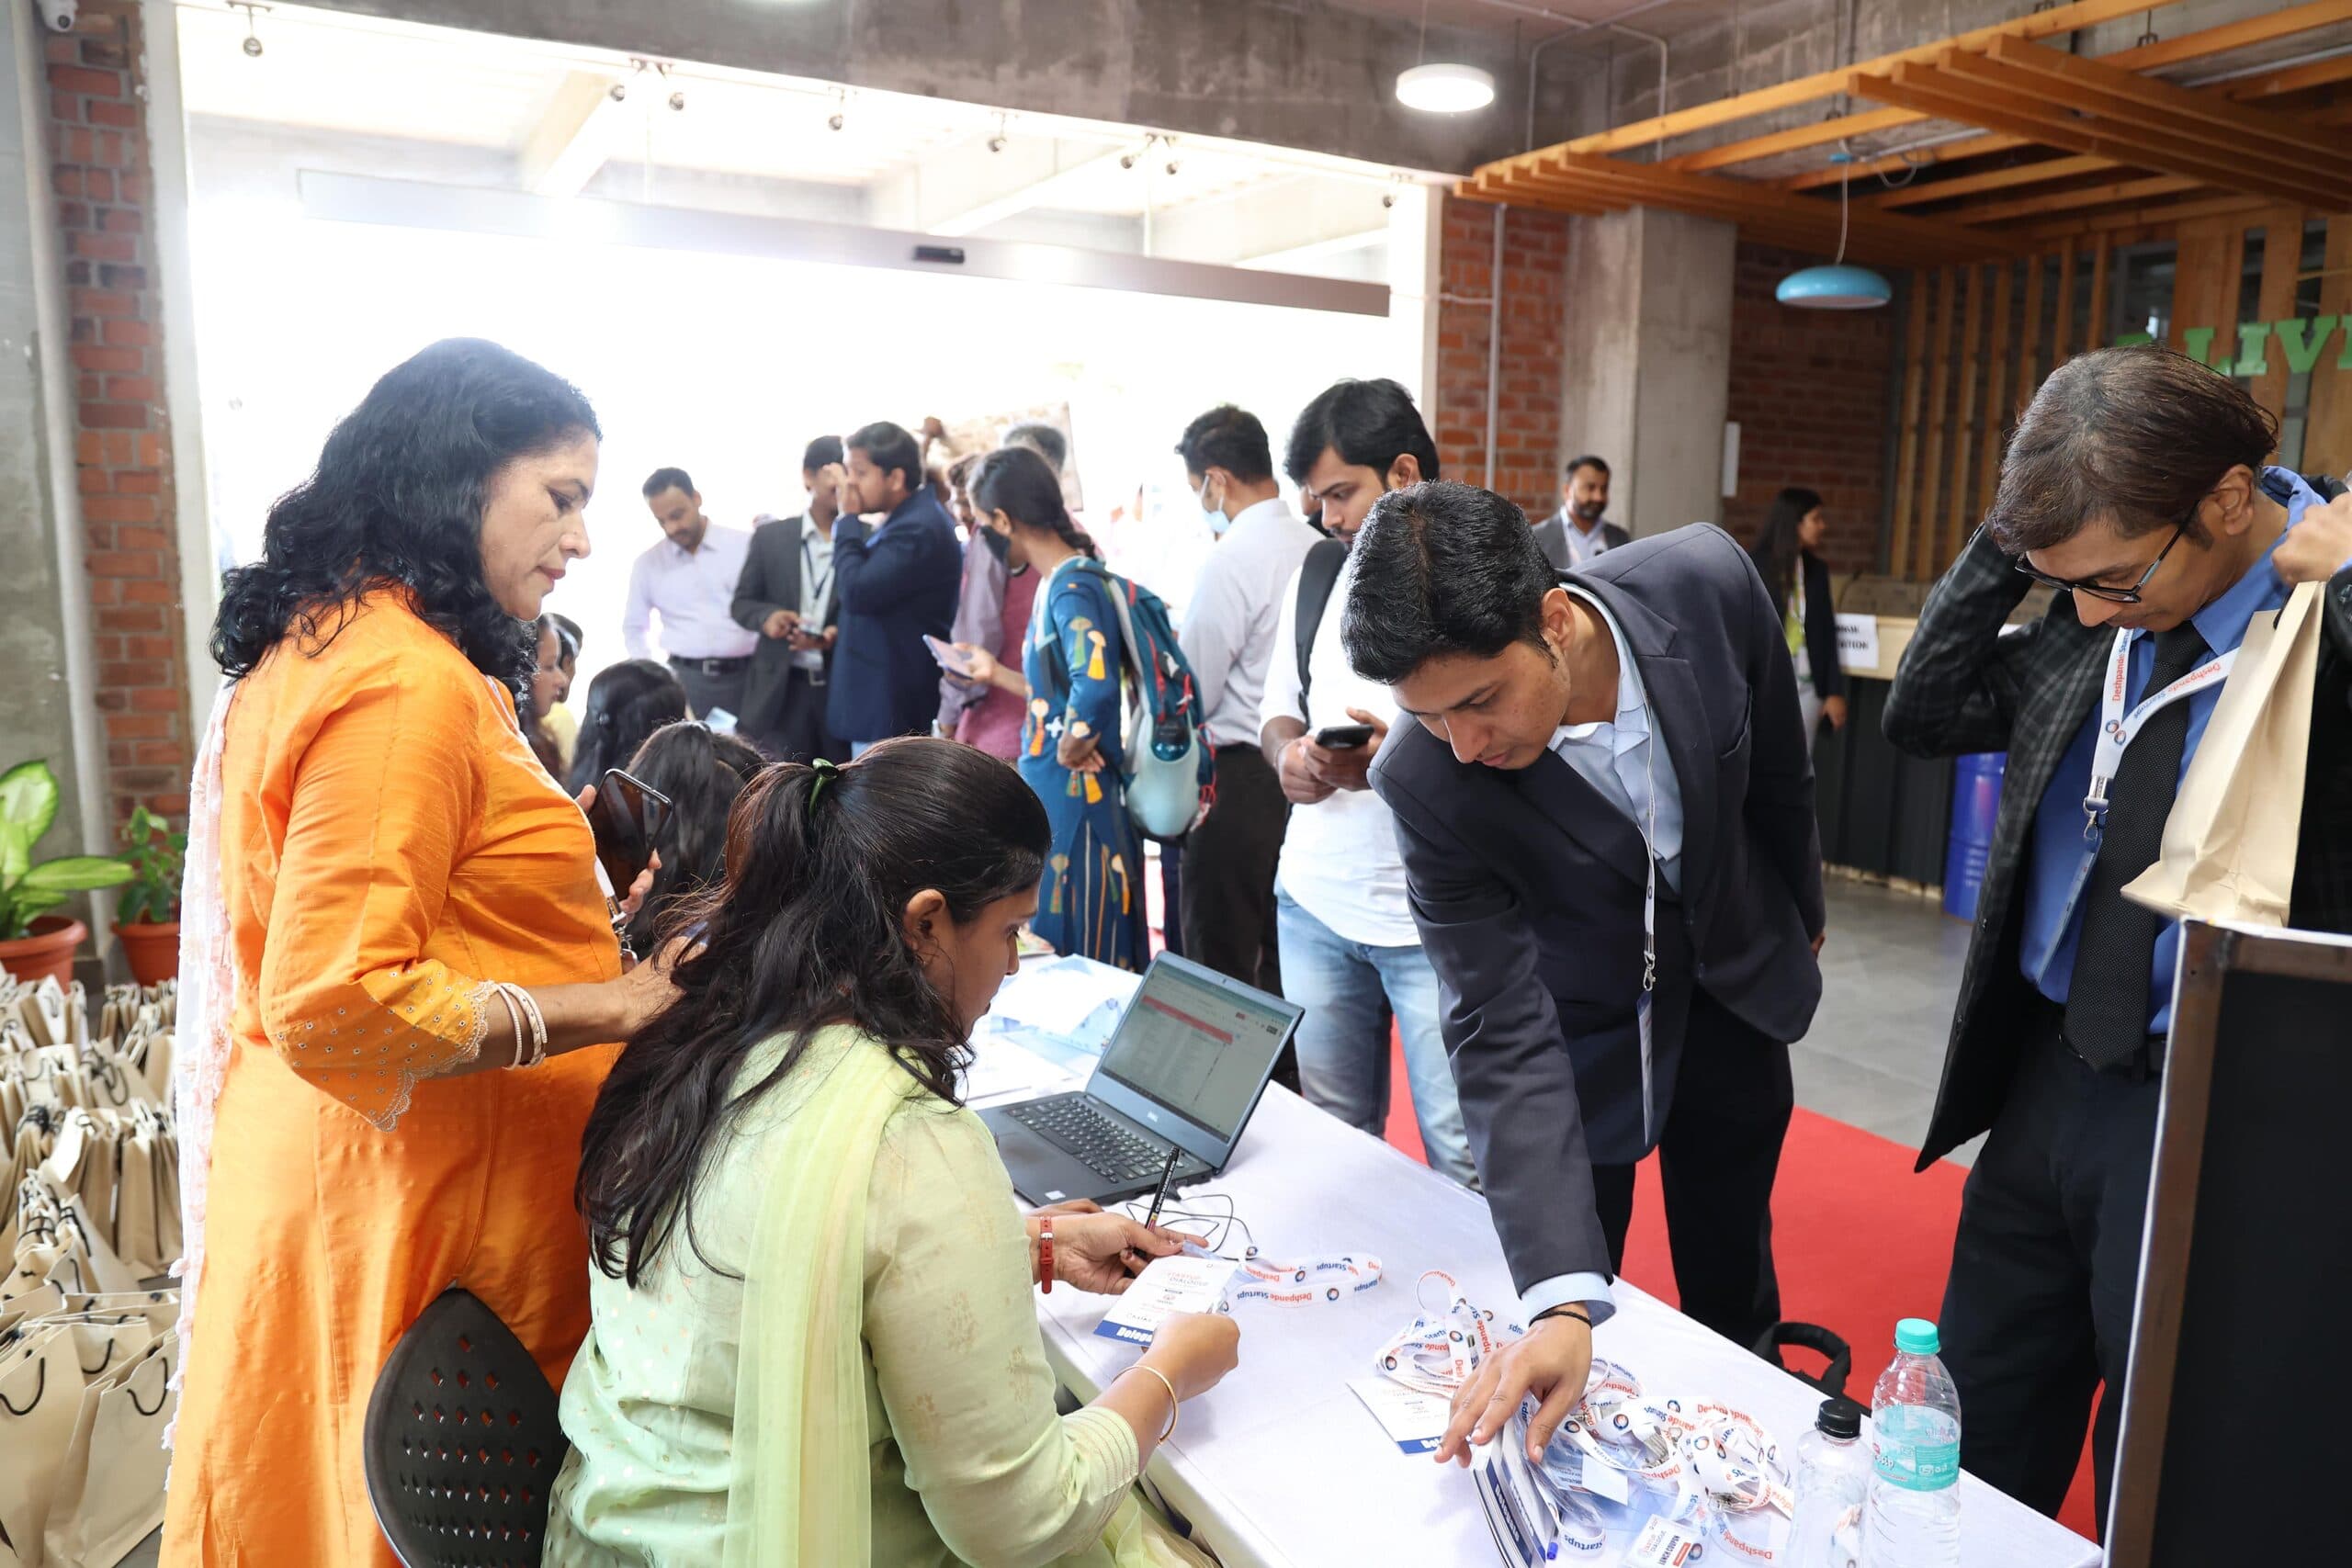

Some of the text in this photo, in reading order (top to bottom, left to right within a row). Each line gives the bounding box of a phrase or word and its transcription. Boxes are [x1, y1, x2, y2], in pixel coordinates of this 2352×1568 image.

[2183, 315, 2352, 377] LIV
[1237, 1290, 1312, 1303] Deshpande Startups
[1477, 1319, 1492, 1353] hpande
